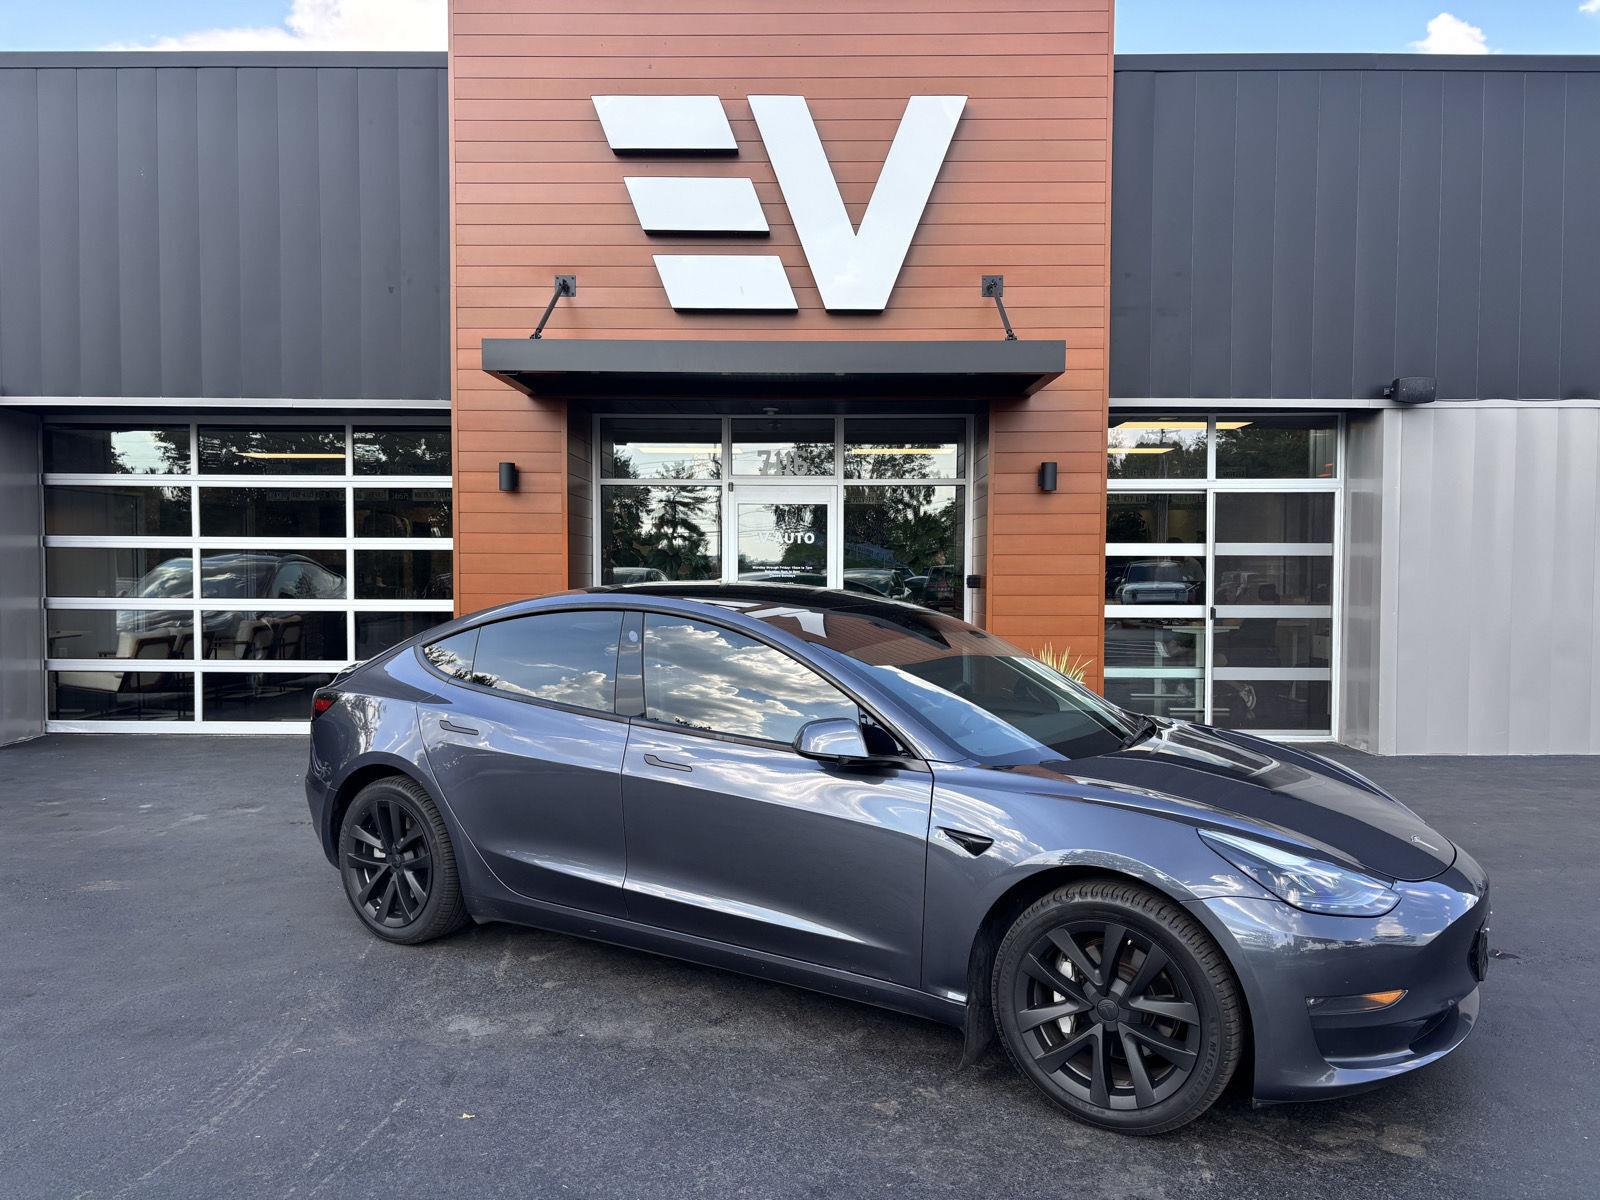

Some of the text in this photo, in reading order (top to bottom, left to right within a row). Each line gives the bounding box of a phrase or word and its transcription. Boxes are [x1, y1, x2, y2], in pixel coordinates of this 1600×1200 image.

[590, 95, 968, 312] EV
[775, 532, 815, 544] AUTO
[1187, 1040, 1217, 1103] MICHELIN
